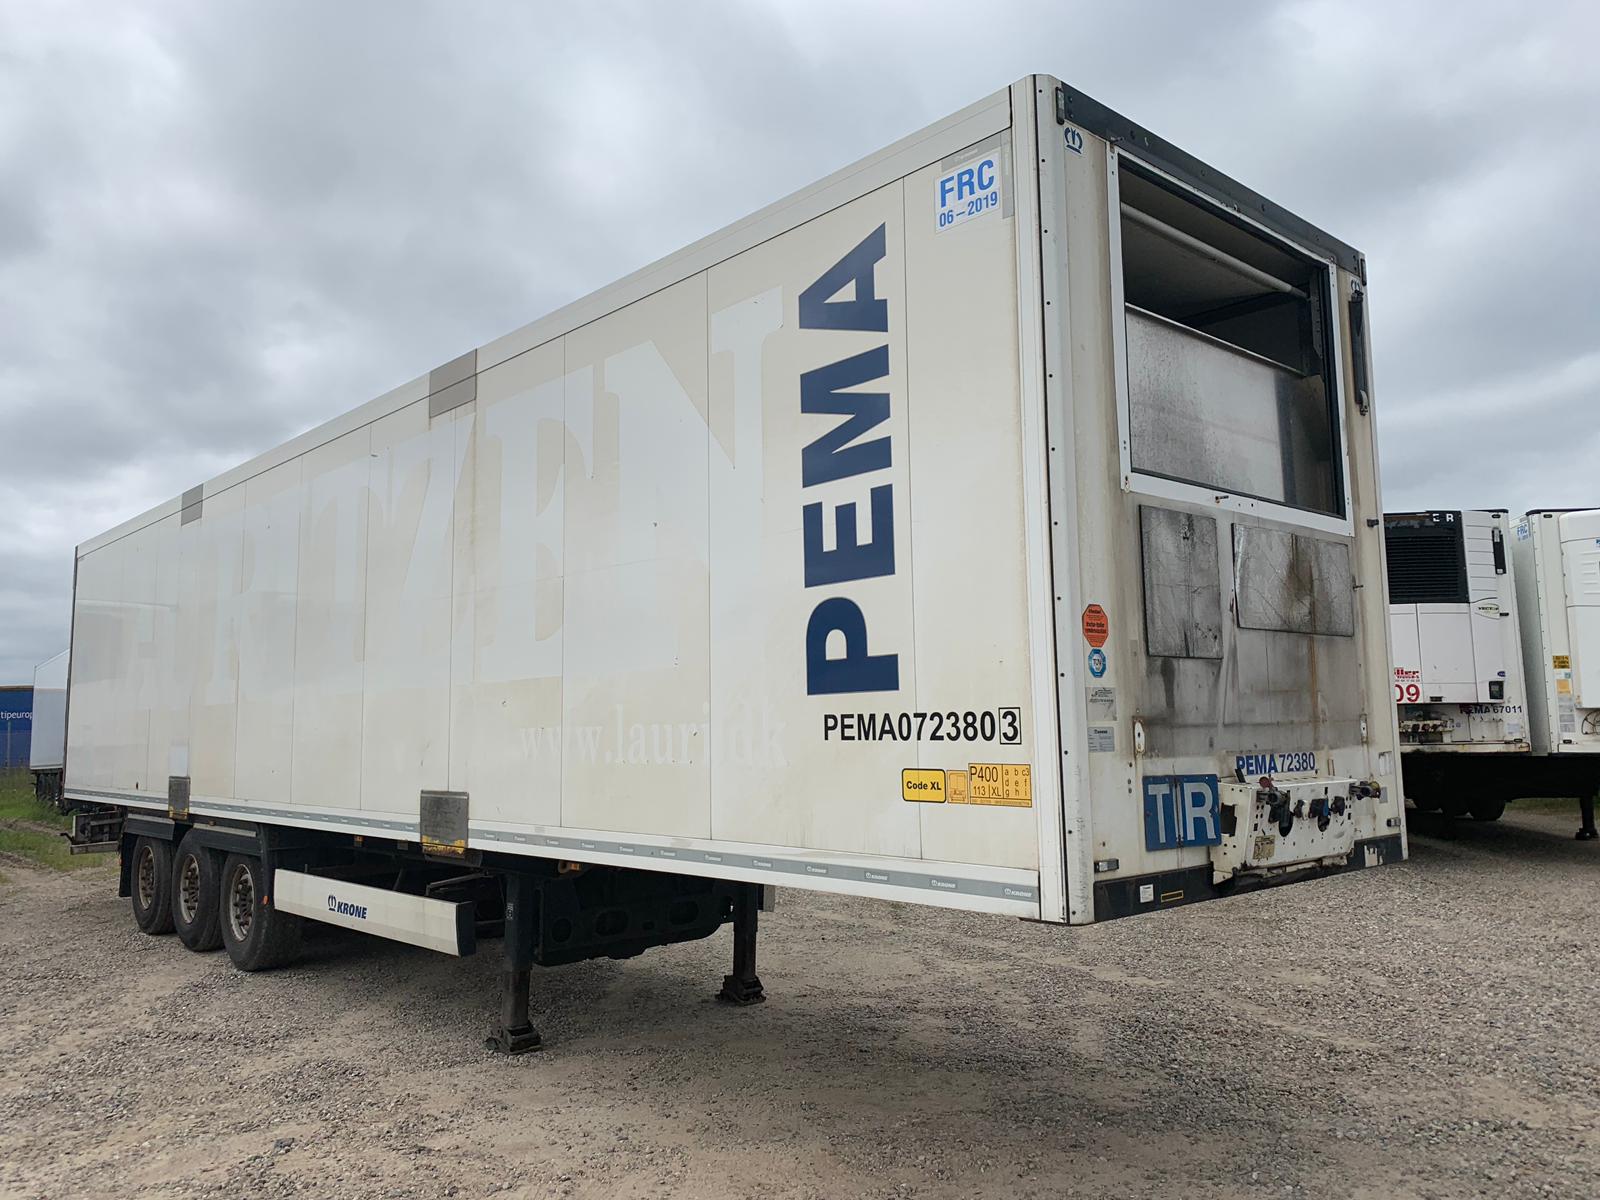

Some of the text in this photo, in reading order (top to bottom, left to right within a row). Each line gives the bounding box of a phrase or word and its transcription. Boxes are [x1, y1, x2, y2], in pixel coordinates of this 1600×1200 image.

[940, 159, 995, 208] FRC
[798, 221, 900, 697] PEMA
[1492, 704, 1523, 714] 67011
[823, 710, 1019, 742] PEMA072380 3
[1004, 768, 1009, 776] a
[1014, 767, 1019, 776] b
[1235, 751, 1316, 776] PEMA 72380
[970, 765, 999, 783] P400
[1004, 778, 1009, 787] d
[906, 780, 942, 791] Code XL
[973, 785, 1002, 797] 113 XL
[1004, 788, 1010, 797] g
[1014, 787, 1019, 796] h
[1148, 782, 1217, 843] TIR
[337, 901, 367, 919] KRONE
